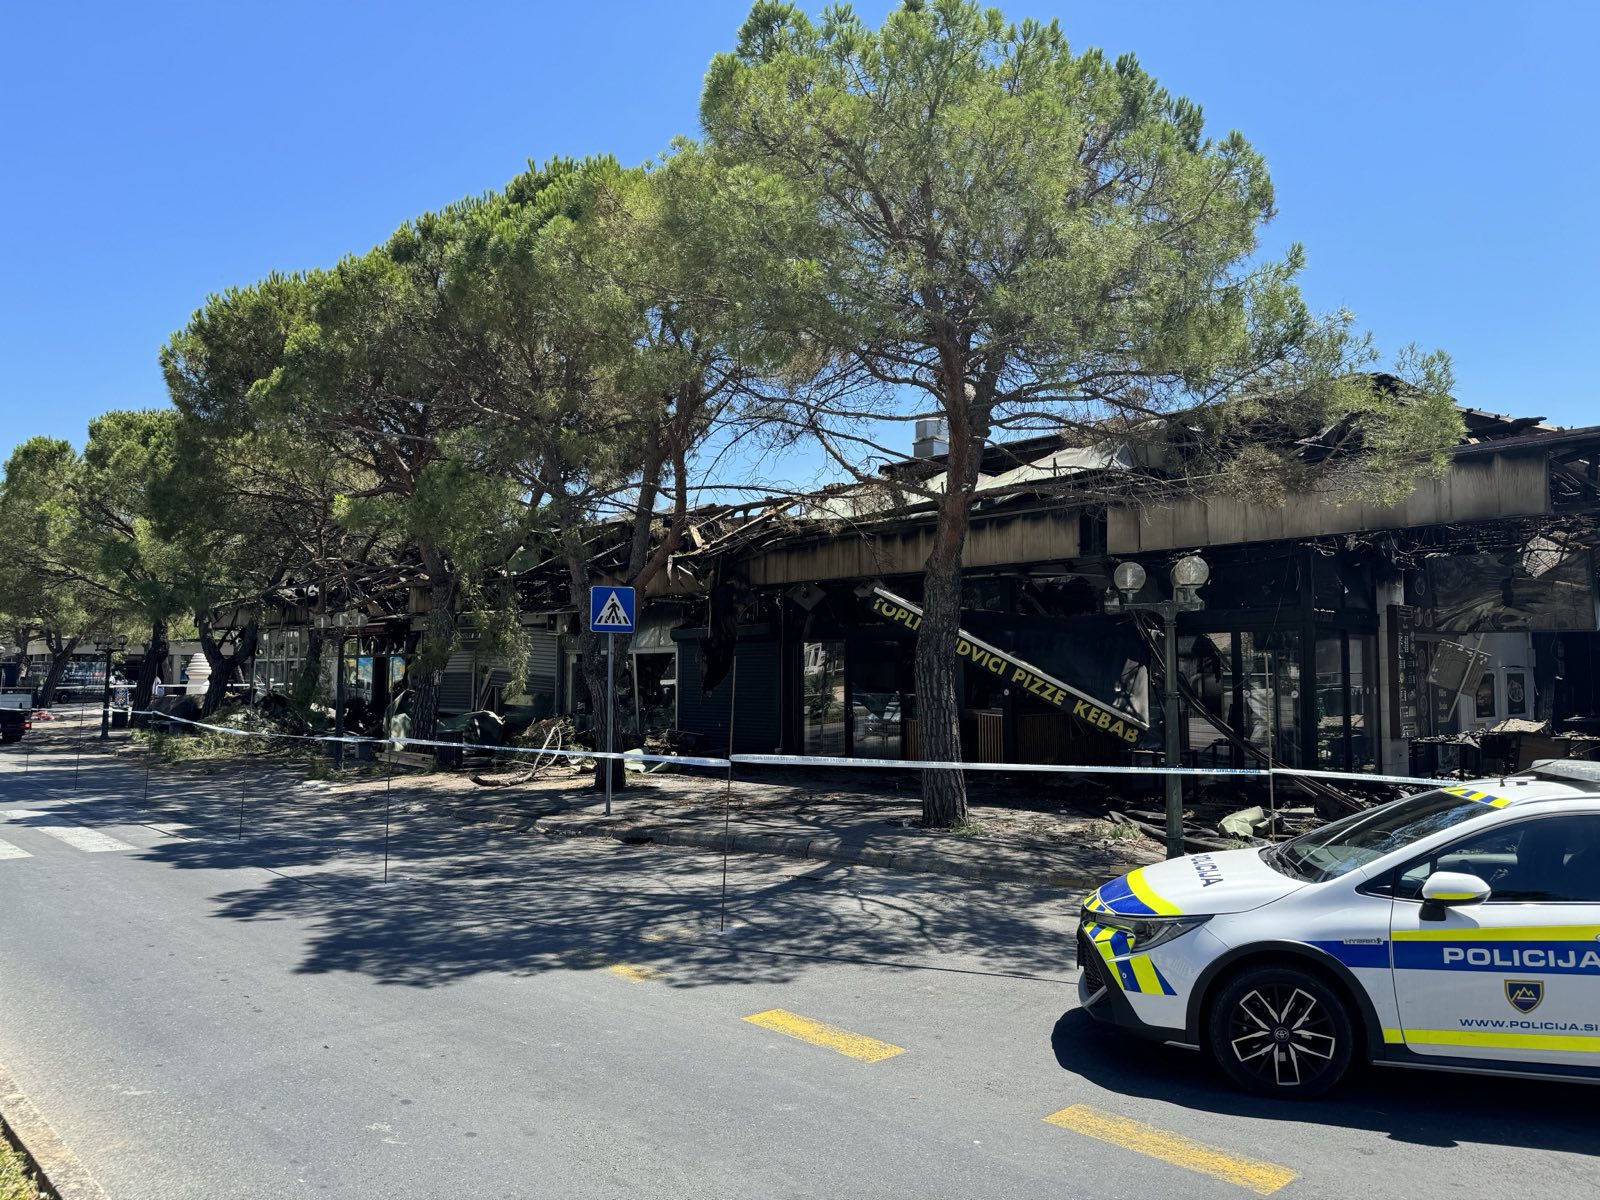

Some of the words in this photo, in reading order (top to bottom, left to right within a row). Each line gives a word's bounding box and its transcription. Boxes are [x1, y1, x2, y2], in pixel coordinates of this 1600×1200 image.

[873, 597, 922, 631] TOPLI
[956, 637, 1007, 676] DVICI
[1011, 667, 1067, 706] PIZZE
[1072, 698, 1139, 743] KEBAB
[1443, 947, 1600, 968] POLICIJA
[1460, 1018, 1599, 1032] WWW.POLICIJA.SI
